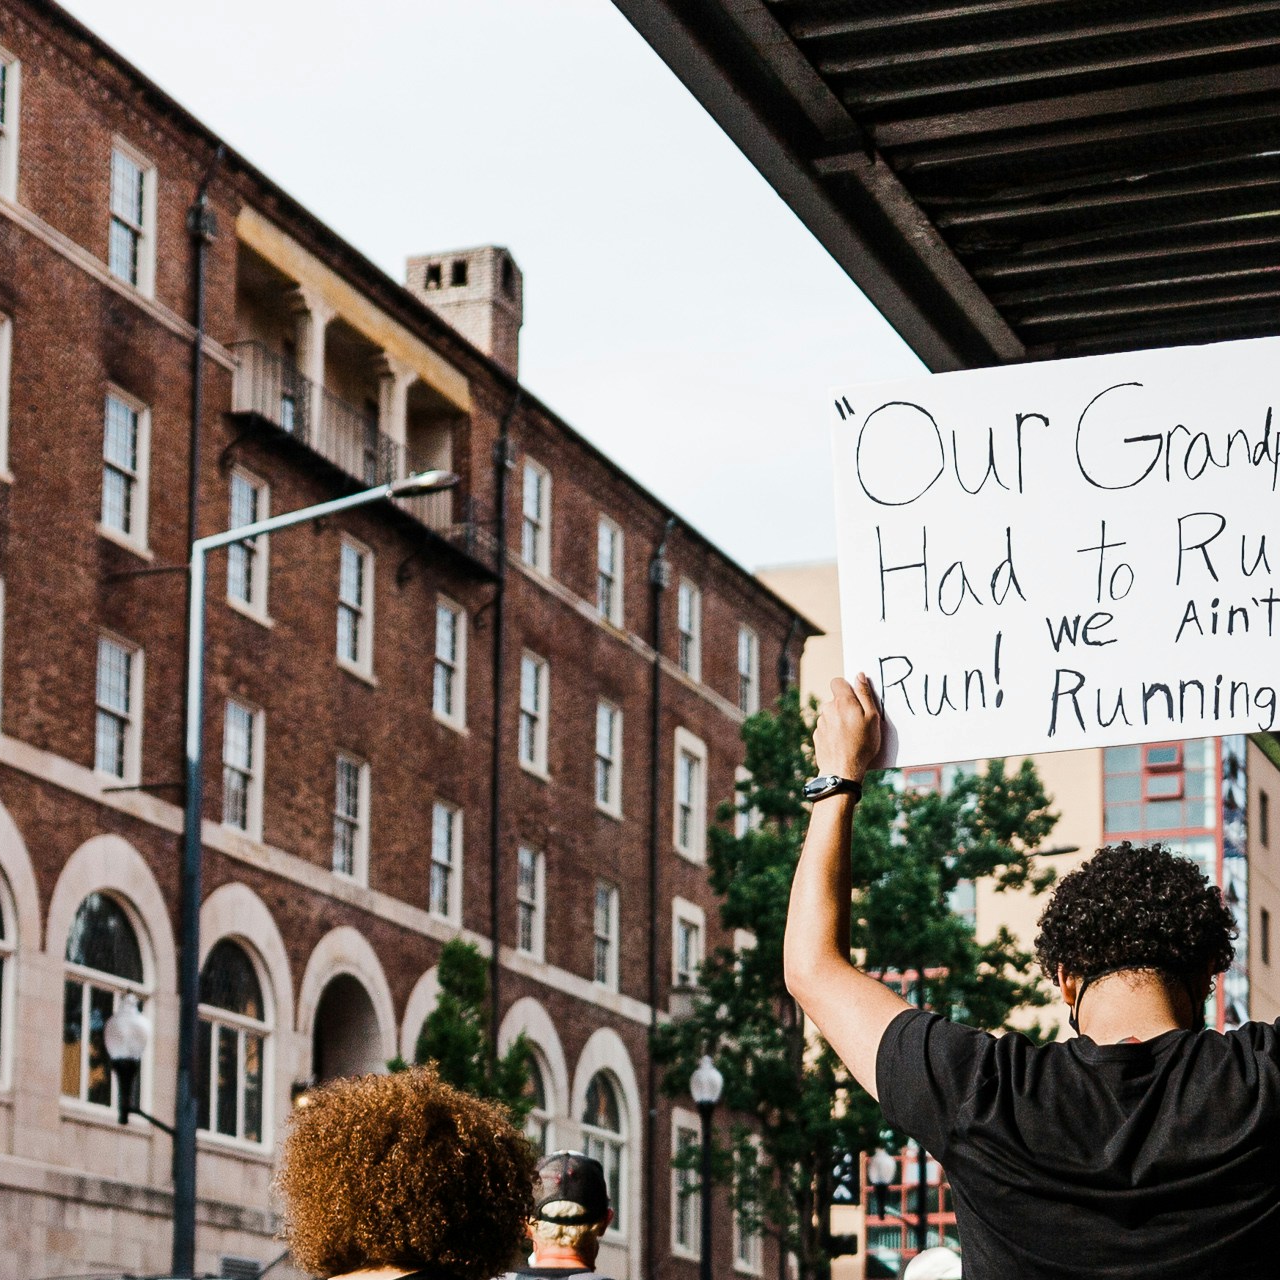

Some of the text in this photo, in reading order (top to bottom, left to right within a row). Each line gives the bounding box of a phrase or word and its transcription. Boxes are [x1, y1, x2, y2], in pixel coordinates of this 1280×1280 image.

[875, 525, 1026, 621] Had
[1077, 520, 1134, 603] to
[878, 631, 1004, 721] Run!
[1047, 668, 1276, 737] Running
